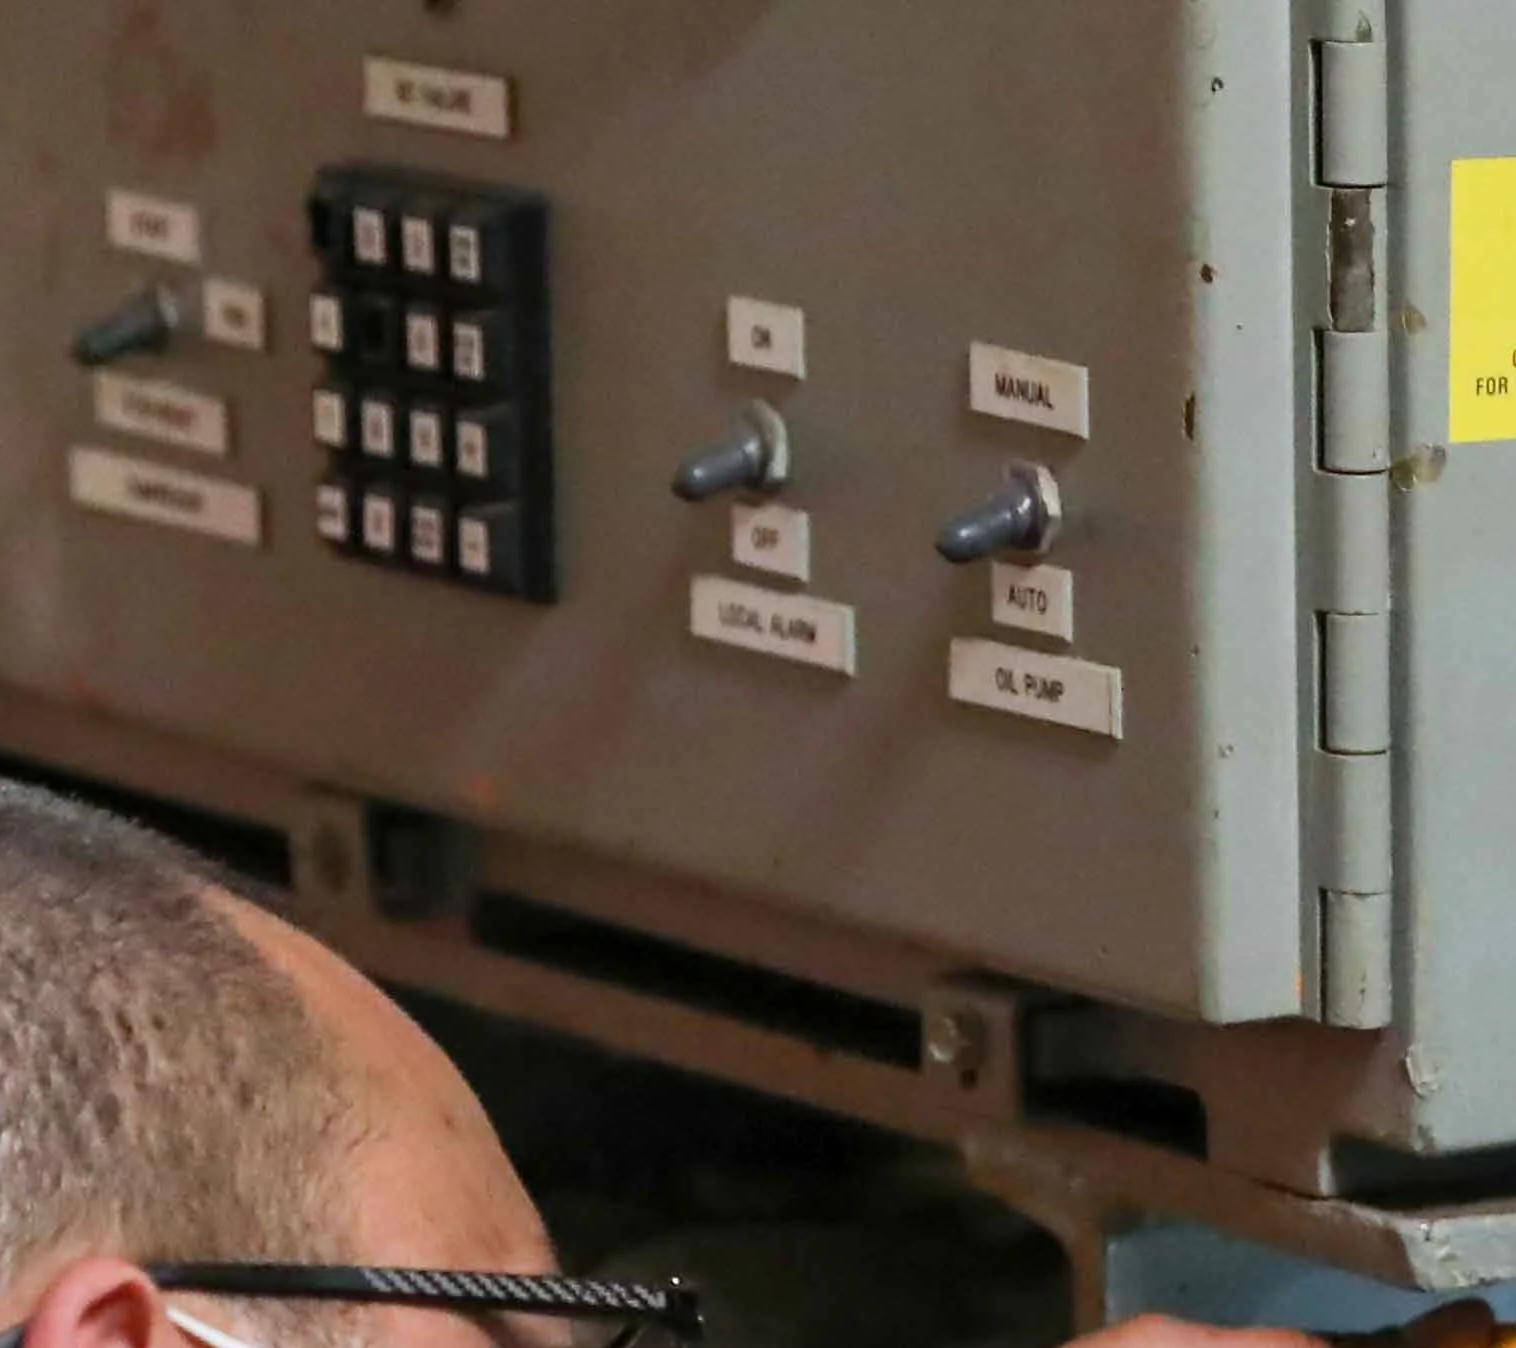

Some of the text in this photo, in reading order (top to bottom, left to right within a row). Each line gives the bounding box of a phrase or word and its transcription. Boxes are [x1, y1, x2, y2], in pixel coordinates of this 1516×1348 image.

[994, 372, 1055, 410] MANUAL
[1475, 375, 1509, 396] FOR
[750, 525, 780, 551] OFF
[1006, 582, 1048, 615] AUTO
[717, 599, 818, 644] LOCAL ALARM
[994, 665, 1065, 703] OIL PUMP
